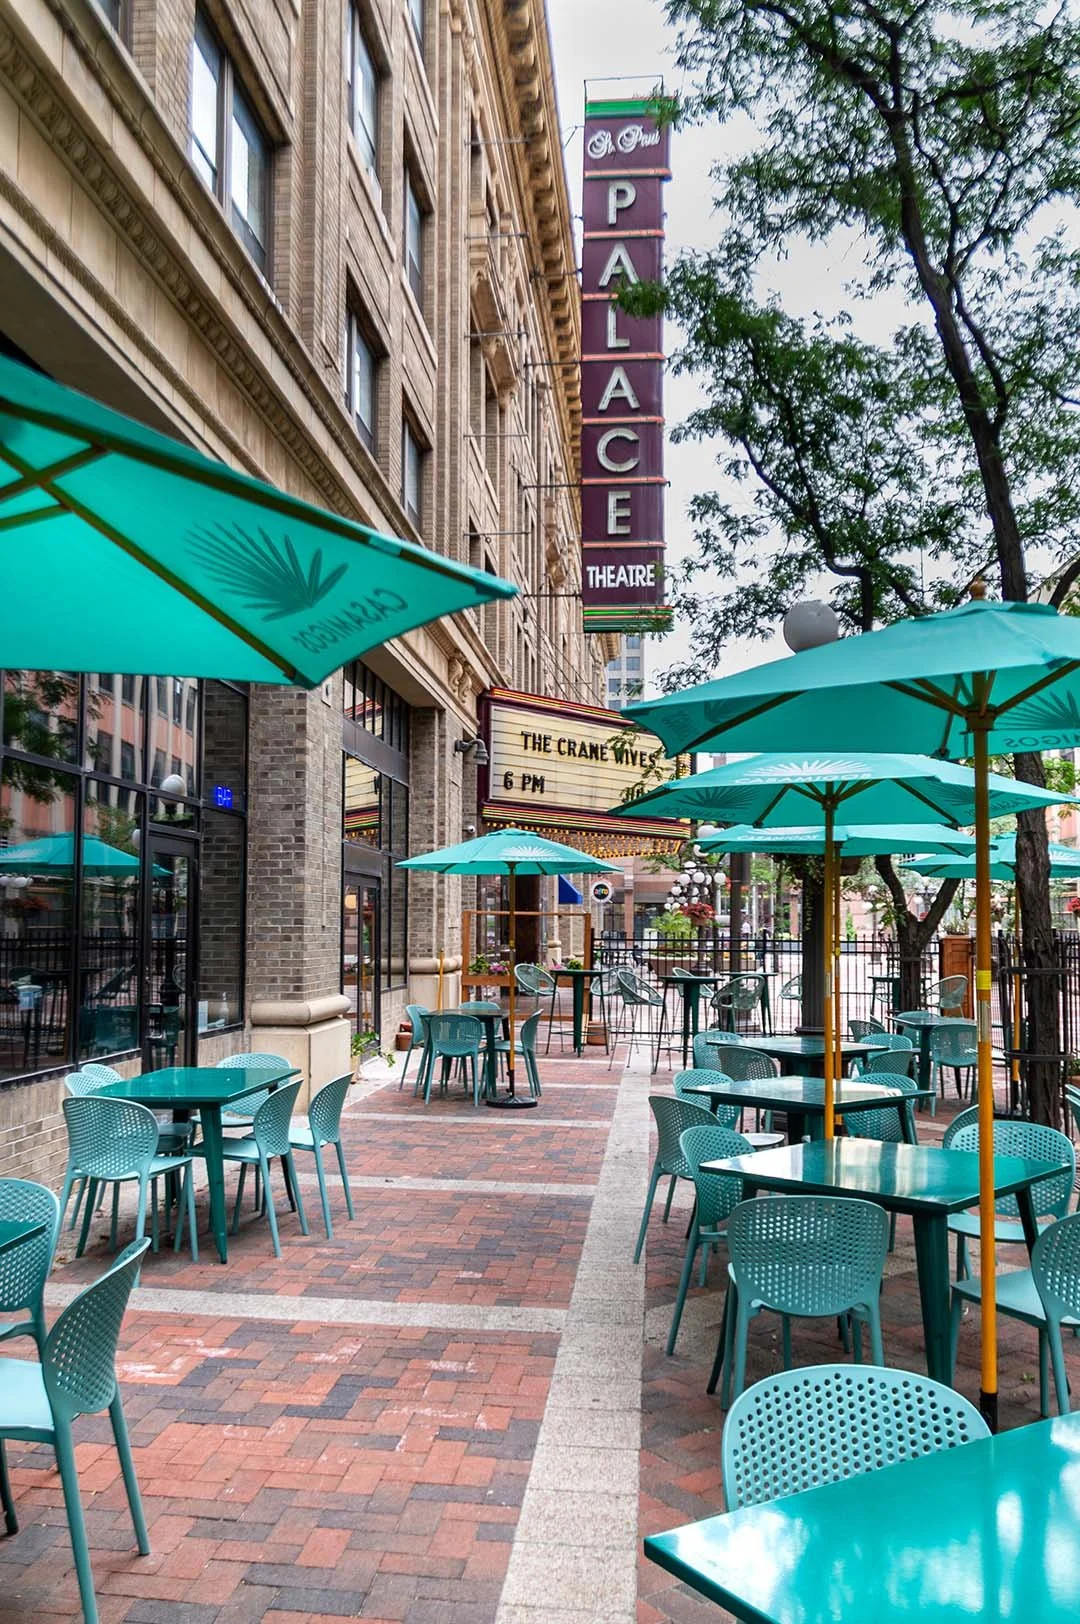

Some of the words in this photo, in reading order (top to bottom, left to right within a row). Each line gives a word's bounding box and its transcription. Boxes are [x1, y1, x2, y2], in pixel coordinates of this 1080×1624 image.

[617, 124, 661, 154] Paul
[597, 181, 640, 536] PALACE
[585, 564, 655, 589] THEATRE
[520, 730, 553, 754] THE
[557, 736, 609, 762] CRANE
[611, 744, 657, 770] WIVES
[503, 770, 514, 791] 6
[521, 772, 545, 794] PM
